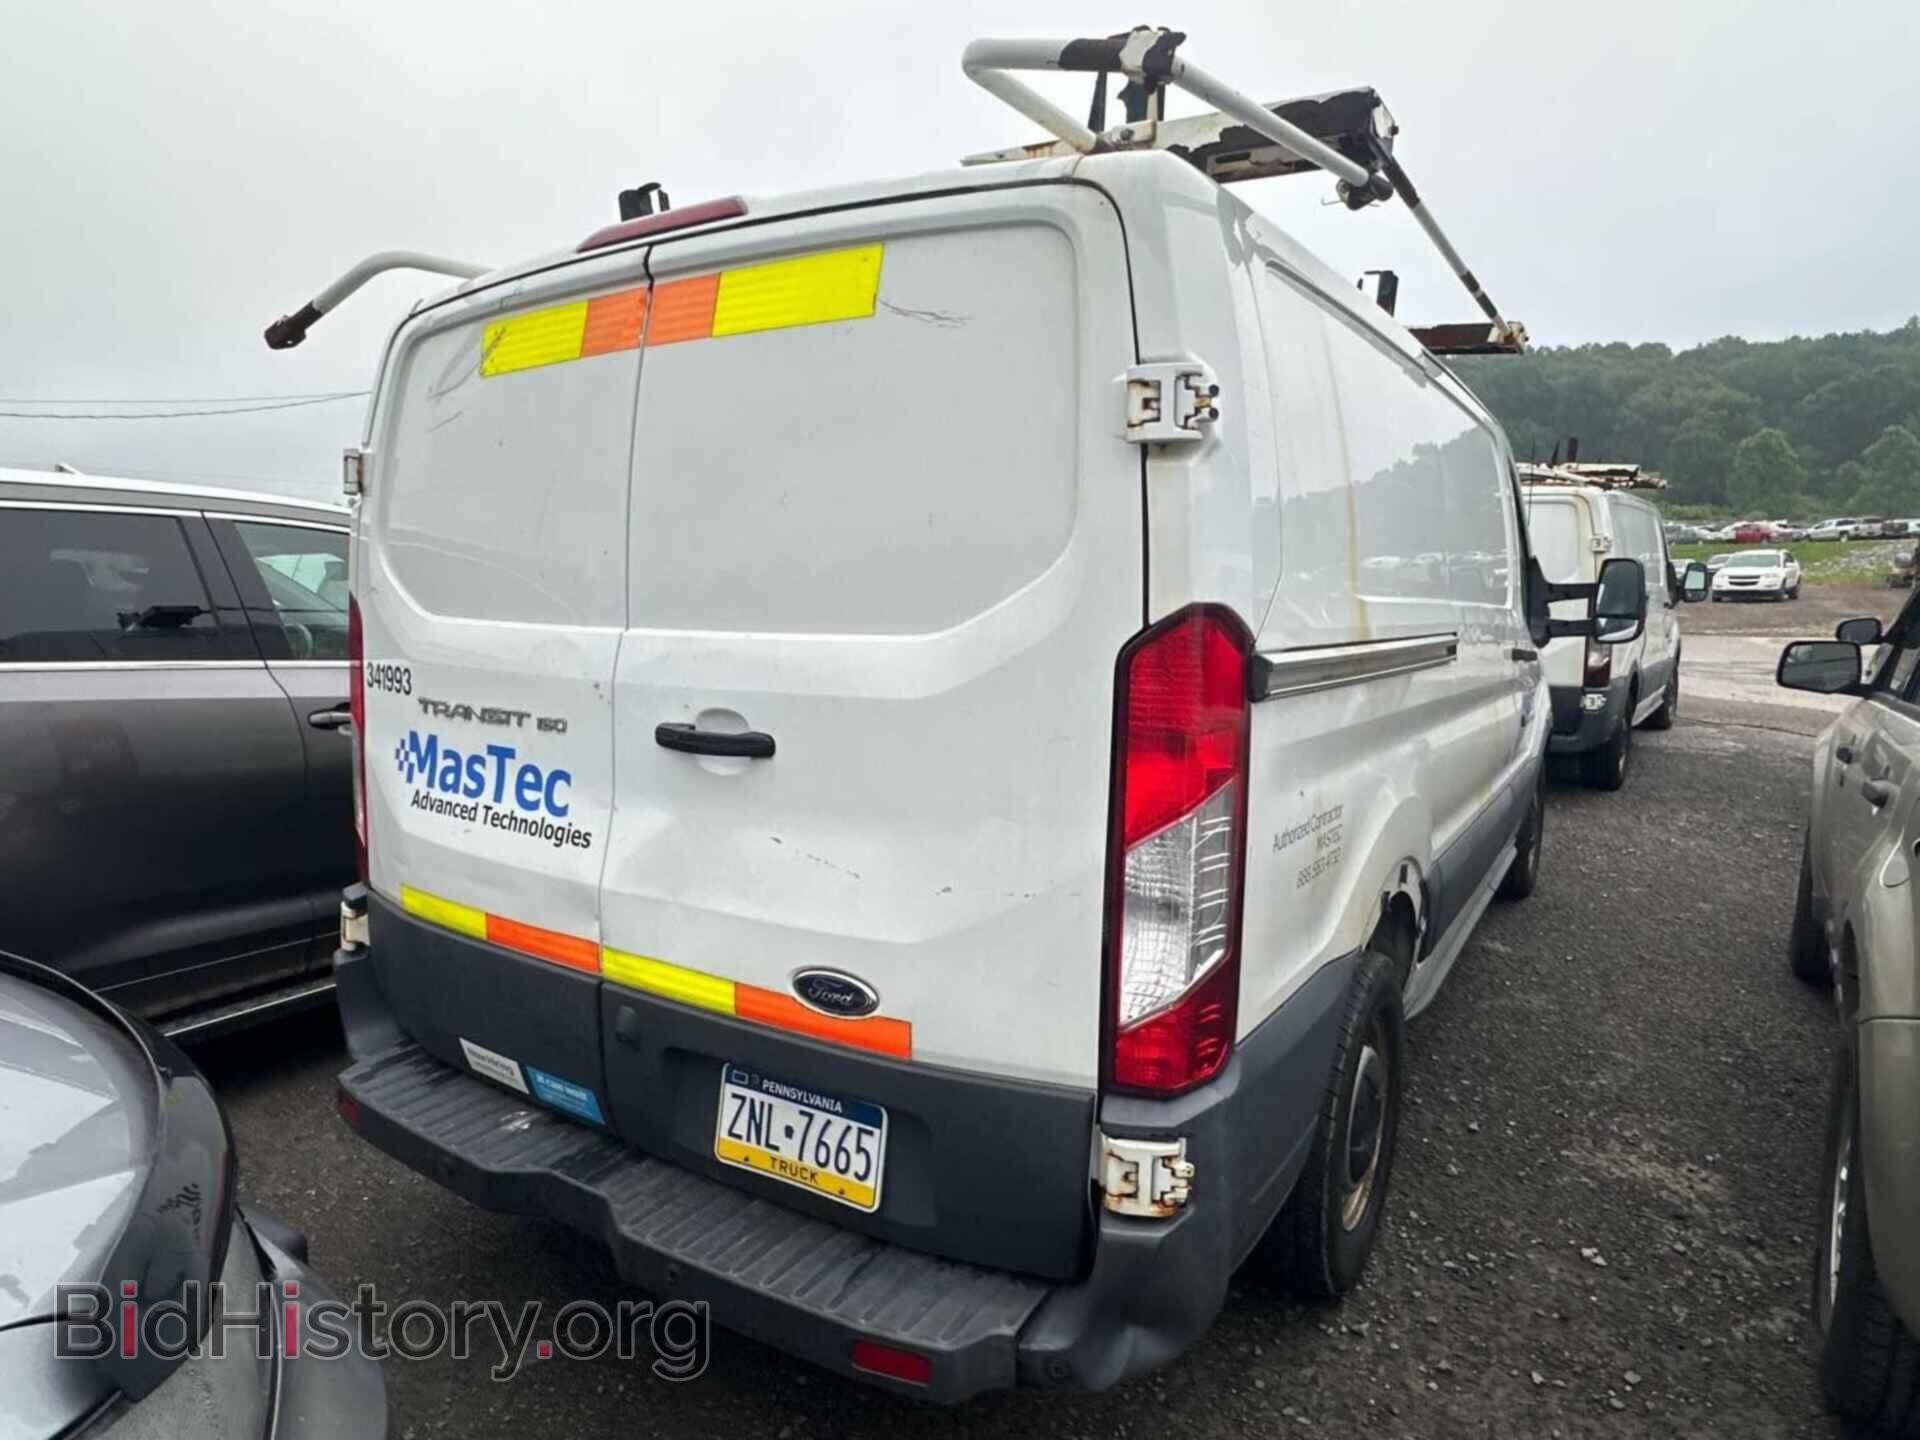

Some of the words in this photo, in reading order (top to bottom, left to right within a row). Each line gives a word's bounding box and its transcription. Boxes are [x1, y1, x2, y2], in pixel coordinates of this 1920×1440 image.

[366, 661, 412, 696] 341993
[418, 696, 532, 728] TRANSIT
[395, 730, 572, 818] MasTec
[411, 788, 479, 822] Advanced
[482, 804, 592, 849] Technologies
[808, 977, 855, 1006] Ford
[762, 1079, 843, 1114] PENNSYLVANIA
[769, 1156, 820, 1186] TRUCK
